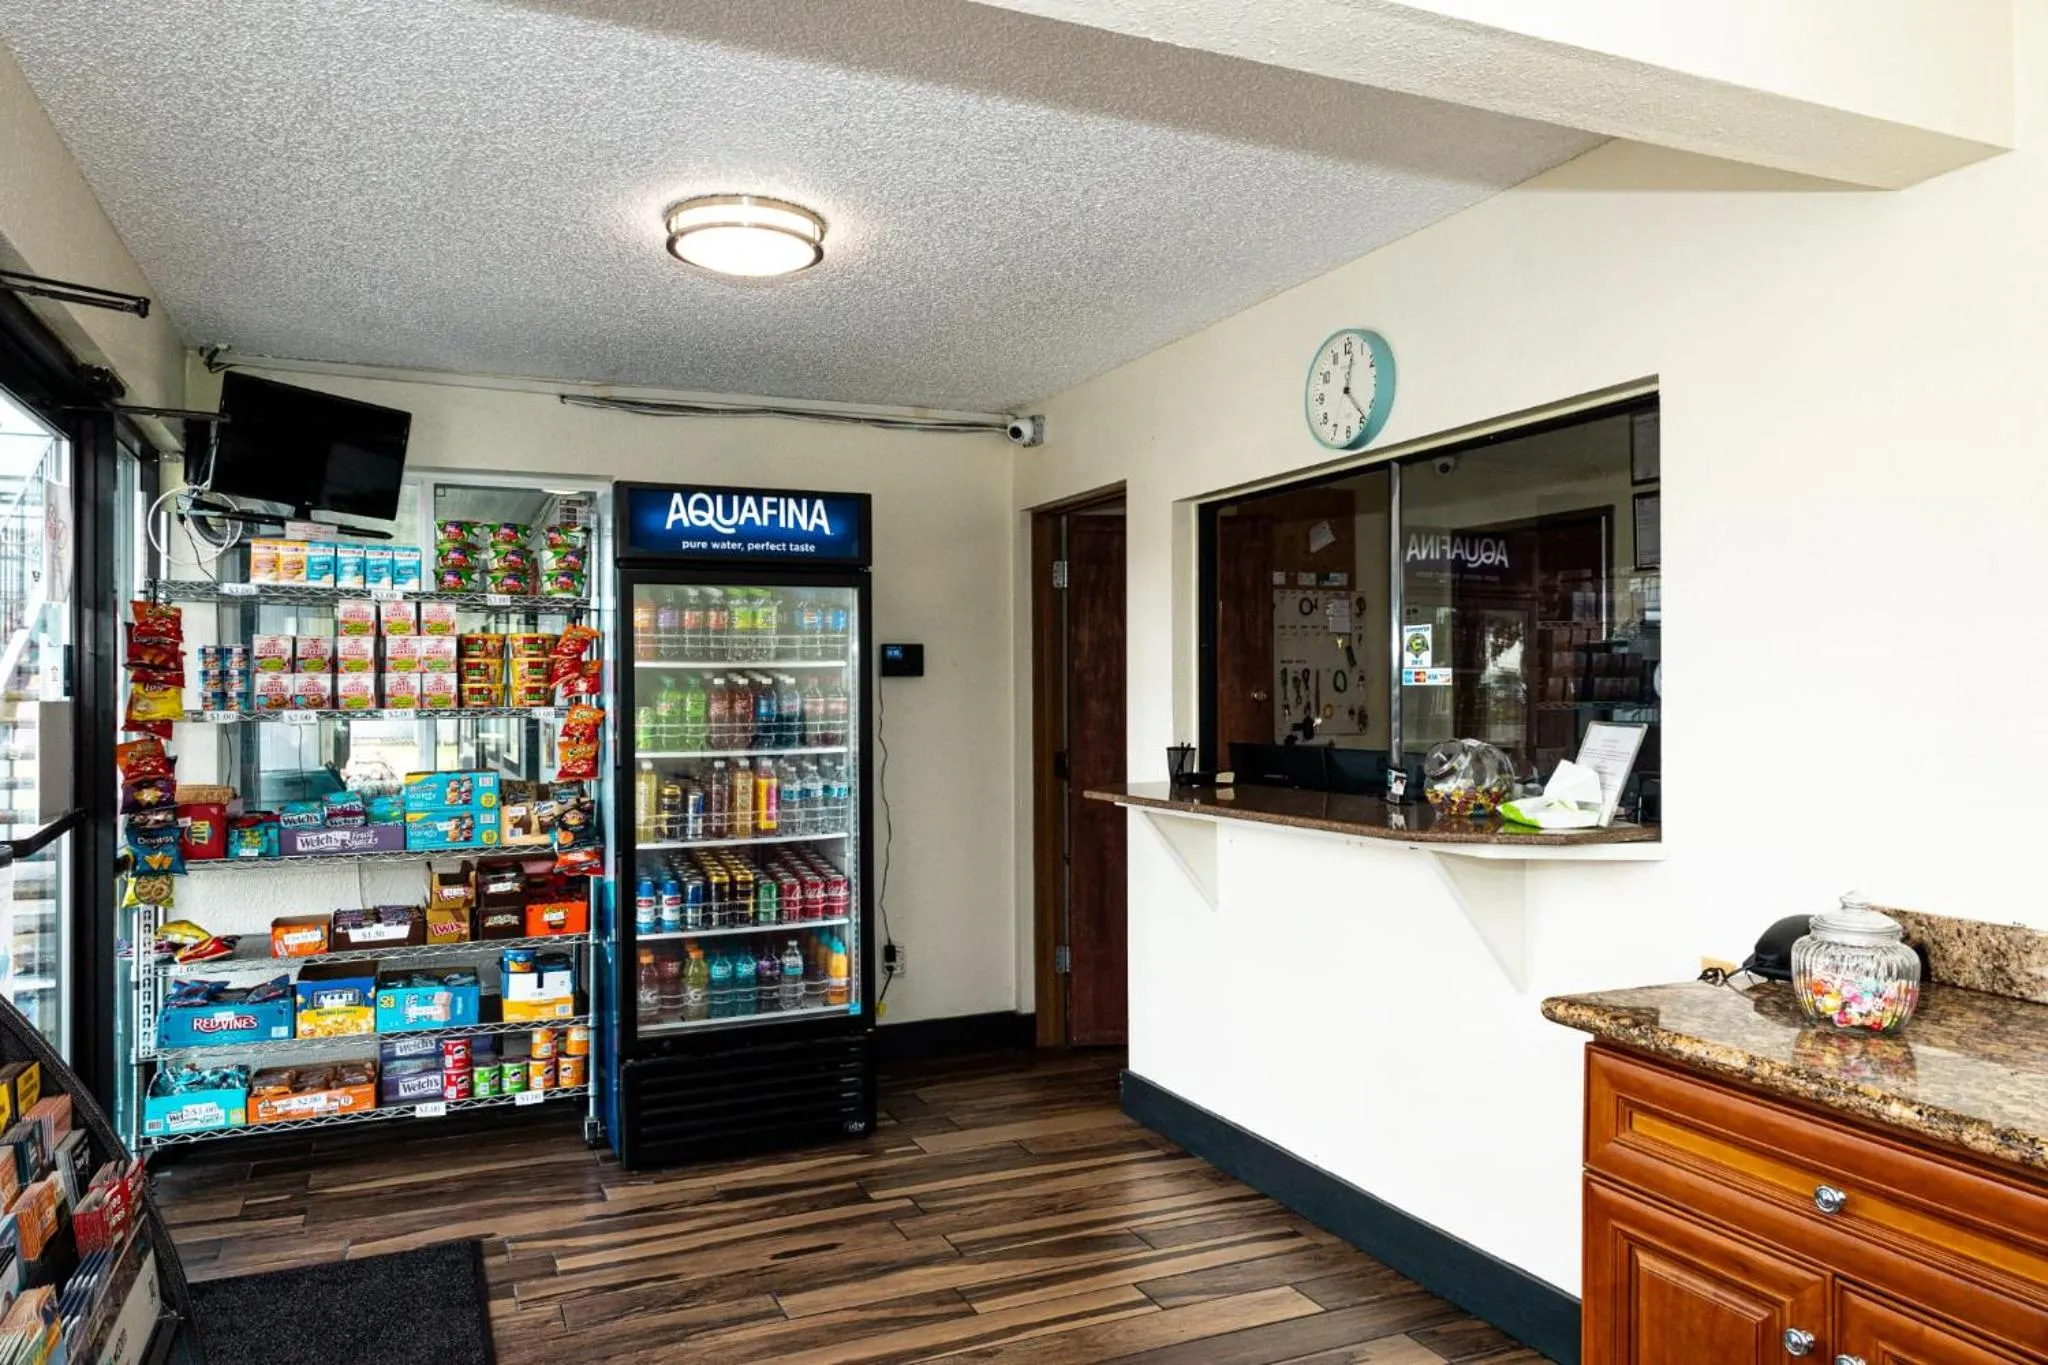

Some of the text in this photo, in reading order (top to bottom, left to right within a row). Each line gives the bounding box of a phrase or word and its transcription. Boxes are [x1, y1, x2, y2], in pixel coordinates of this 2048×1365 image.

[1344, 341, 1352, 355] 12
[1332, 352, 1339, 365] 11
[1323, 370, 1330, 384] 10
[1322, 412, 1328, 425] 8
[1332, 423, 1338, 436] 7
[1345, 425, 1351, 439] 6
[665, 492, 832, 535] AQUAFINA
[682, 540, 816, 552] pure water, perfect taste
[282, 814, 319, 825] Welch's
[191, 820, 209, 845] RITZ
[137, 834, 174, 848] Doritos
[300, 834, 339, 849] Welch's
[221, 1014, 258, 1031] VINES
[398, 1038, 434, 1053] Welch's
[401, 1075, 440, 1092] Welch's
